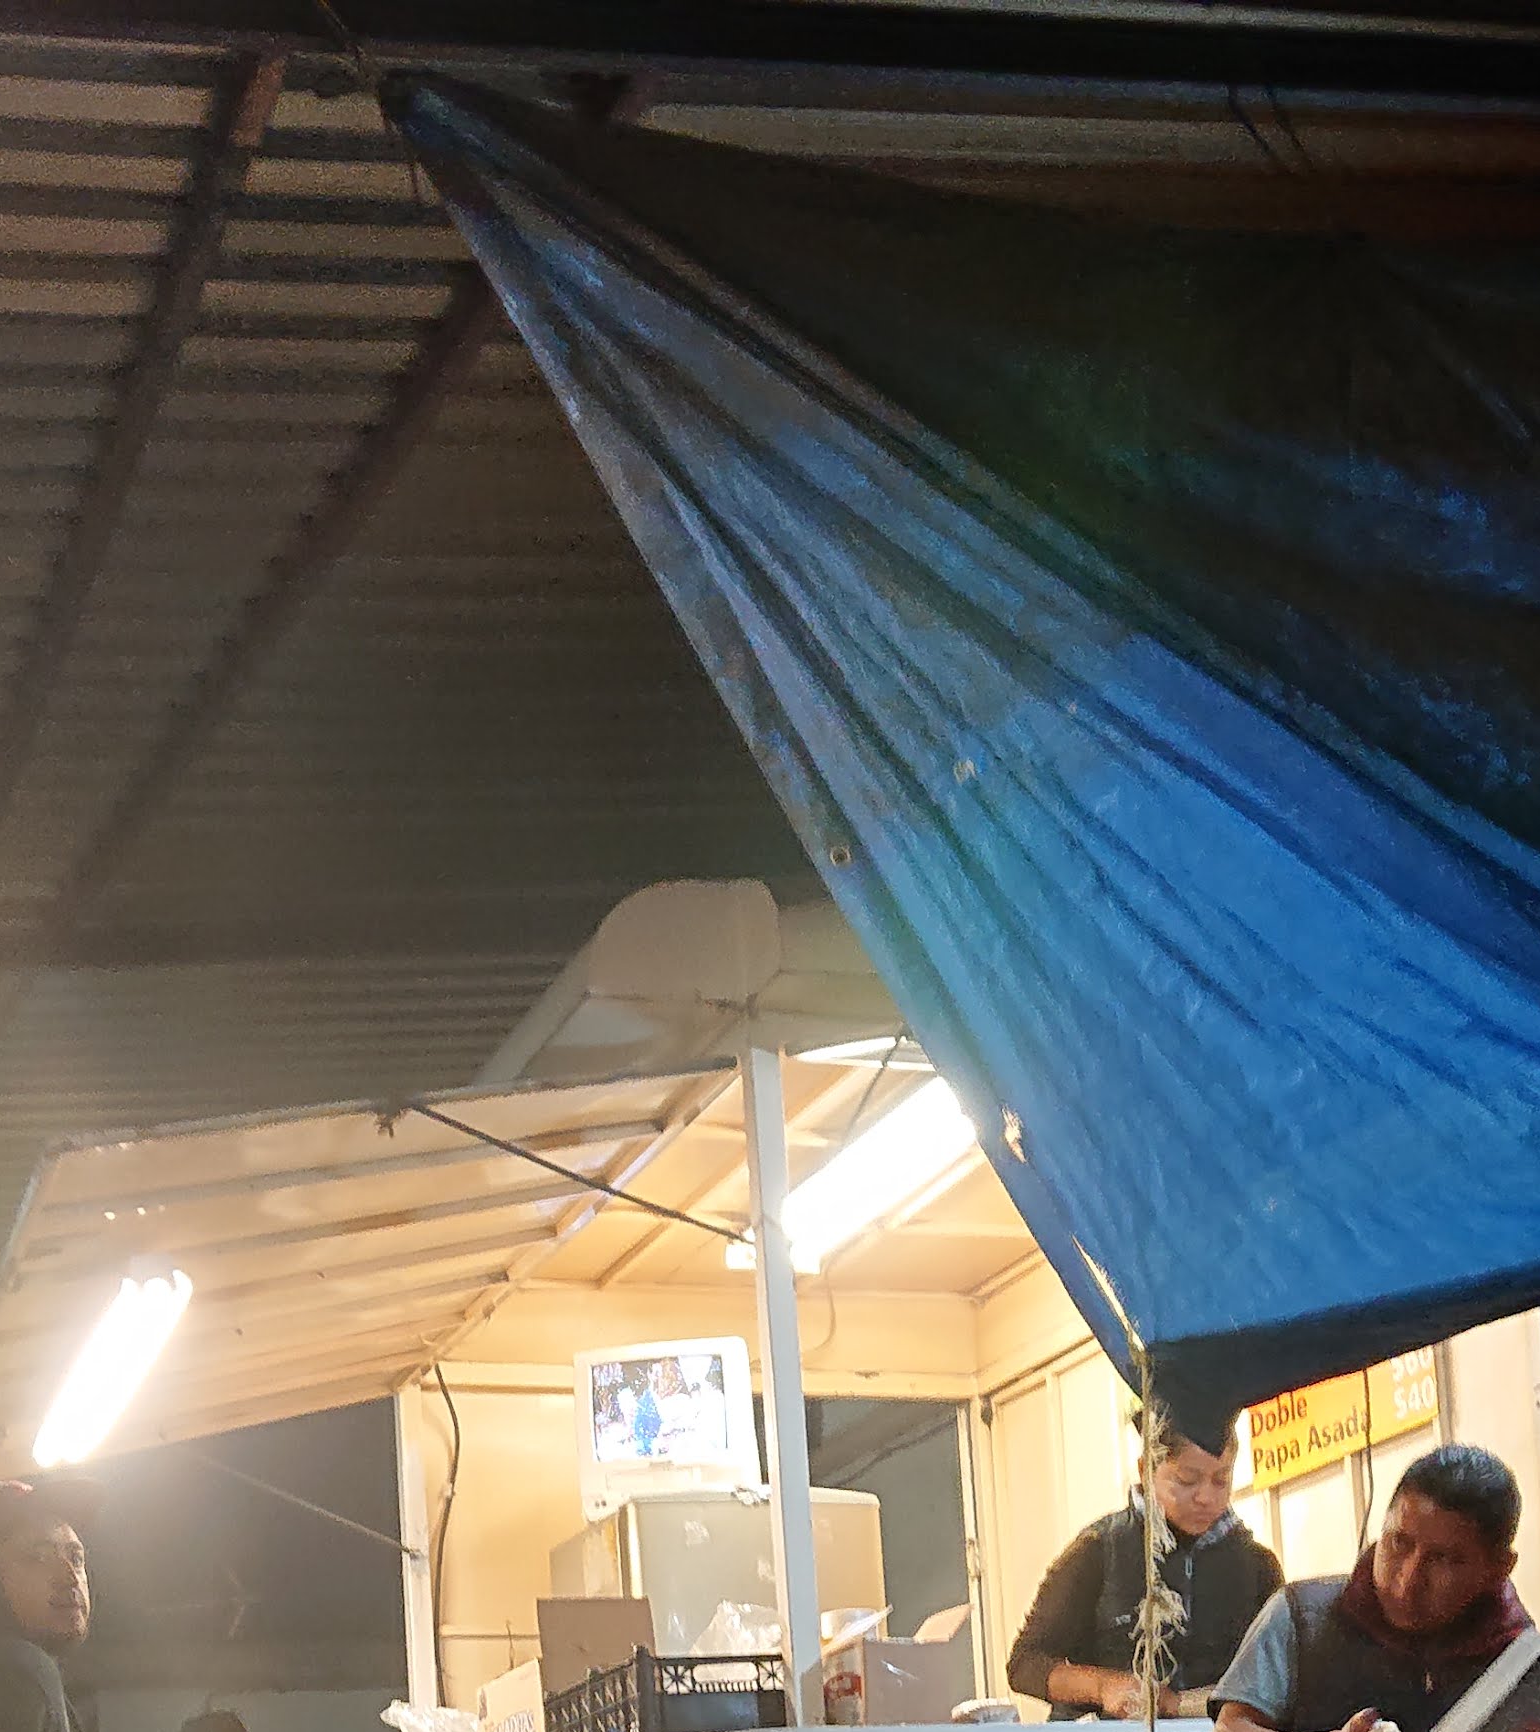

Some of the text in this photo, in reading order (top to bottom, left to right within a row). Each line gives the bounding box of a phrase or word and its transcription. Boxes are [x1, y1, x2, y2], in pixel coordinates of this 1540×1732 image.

[1250, 1392, 1308, 1438] Doble
[1253, 1376, 1436, 1474] Papa Asada $40
